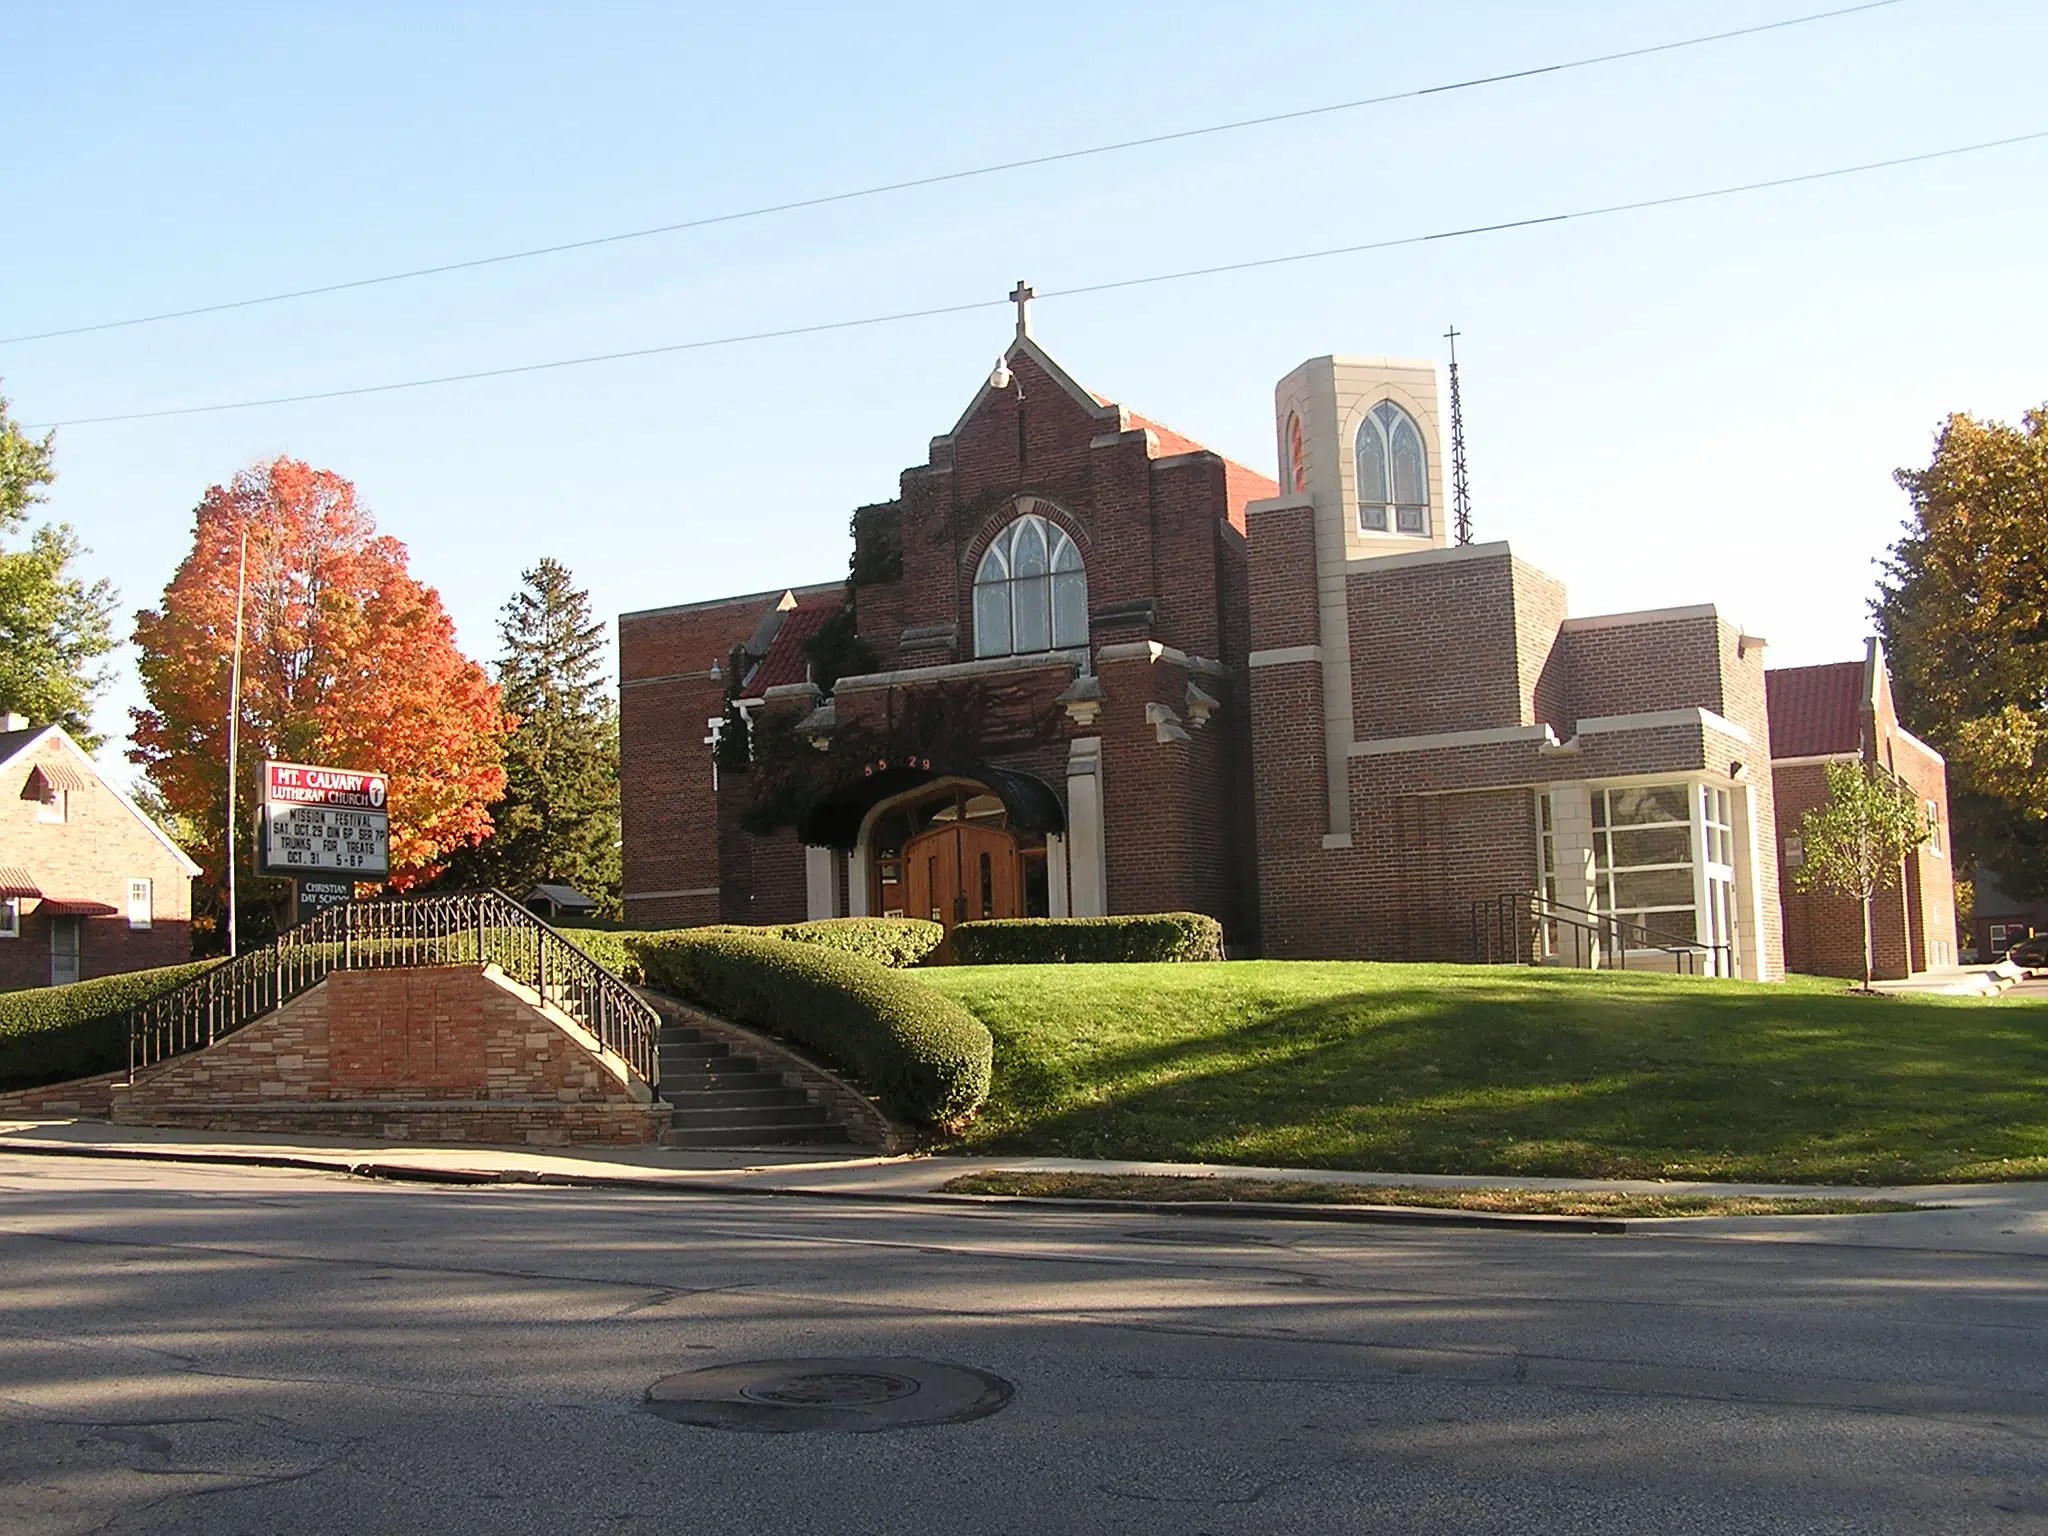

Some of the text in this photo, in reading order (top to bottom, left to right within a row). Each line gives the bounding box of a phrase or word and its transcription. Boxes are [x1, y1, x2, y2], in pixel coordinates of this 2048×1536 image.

[277, 768, 364, 791] MT. CALVARY
[272, 785, 369, 806] LUTHERAN CHURCH
[290, 810, 372, 827] MISSION FESTIVAL
[274, 822, 292, 835] SAT.
[327, 826, 340, 838] DIN
[343, 827, 353, 839] 6P
[359, 829, 372, 840] SER
[376, 830, 385, 841] 7P
[281, 837, 375, 854] TRUNKS FOR TREATS
[305, 882, 347, 893] CHRISTIAN
[301, 893, 316, 903] DAY
